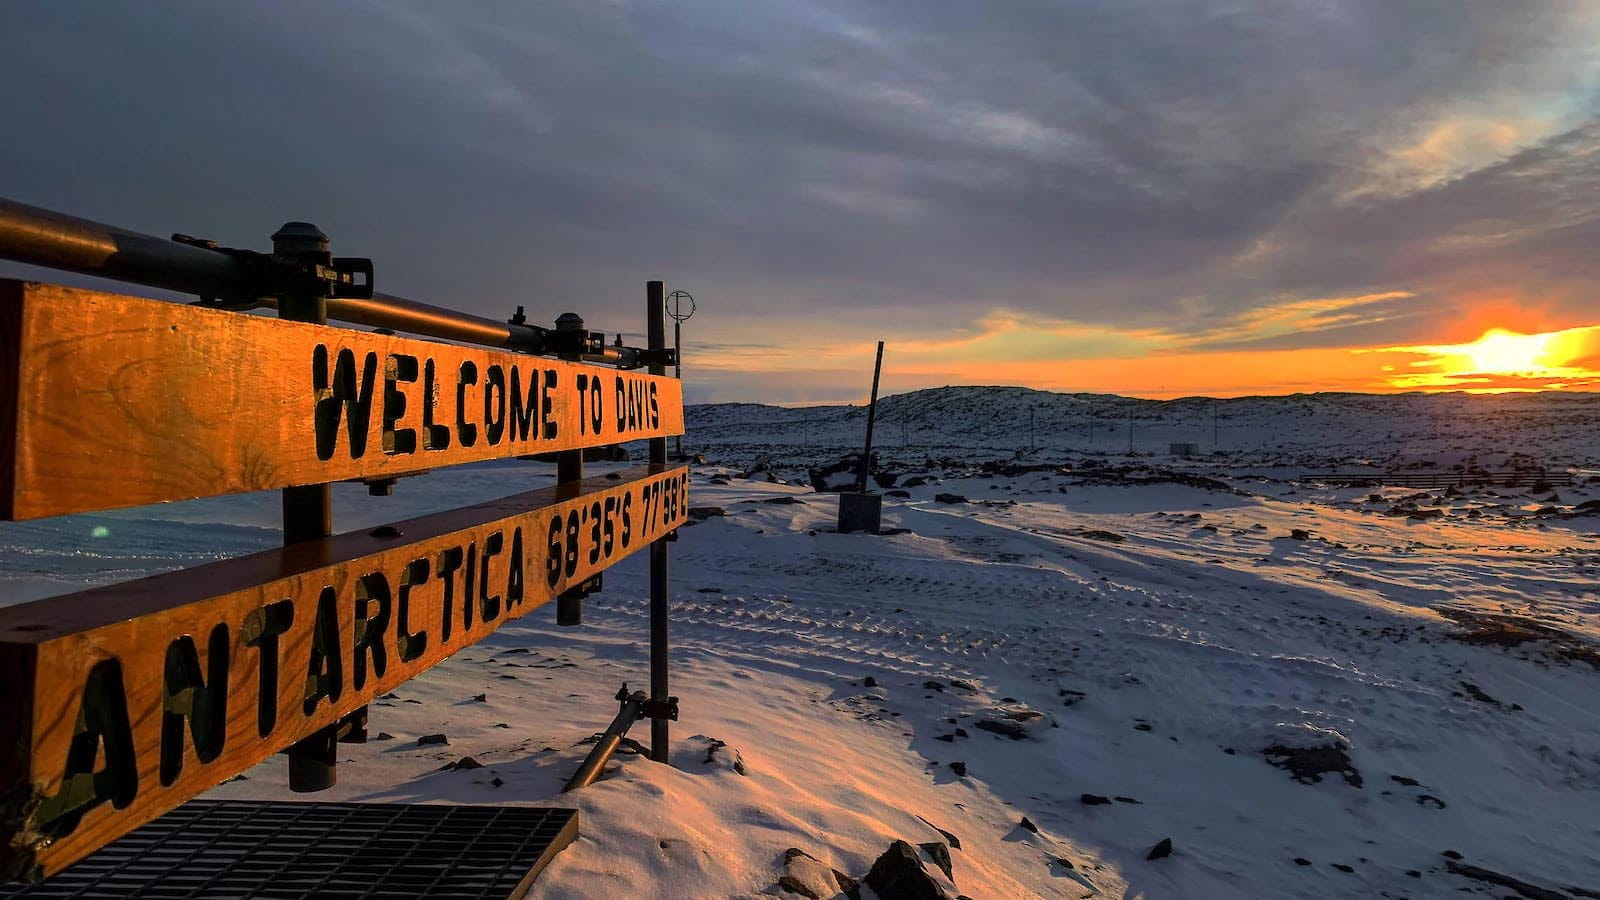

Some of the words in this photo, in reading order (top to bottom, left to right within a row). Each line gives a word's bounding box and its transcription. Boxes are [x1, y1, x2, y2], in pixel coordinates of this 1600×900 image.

[313, 343, 557, 461] WELCOME
[577, 374, 602, 436] TO
[616, 376, 658, 433] DAVIS
[36, 526, 524, 839] ANTARCTICA
